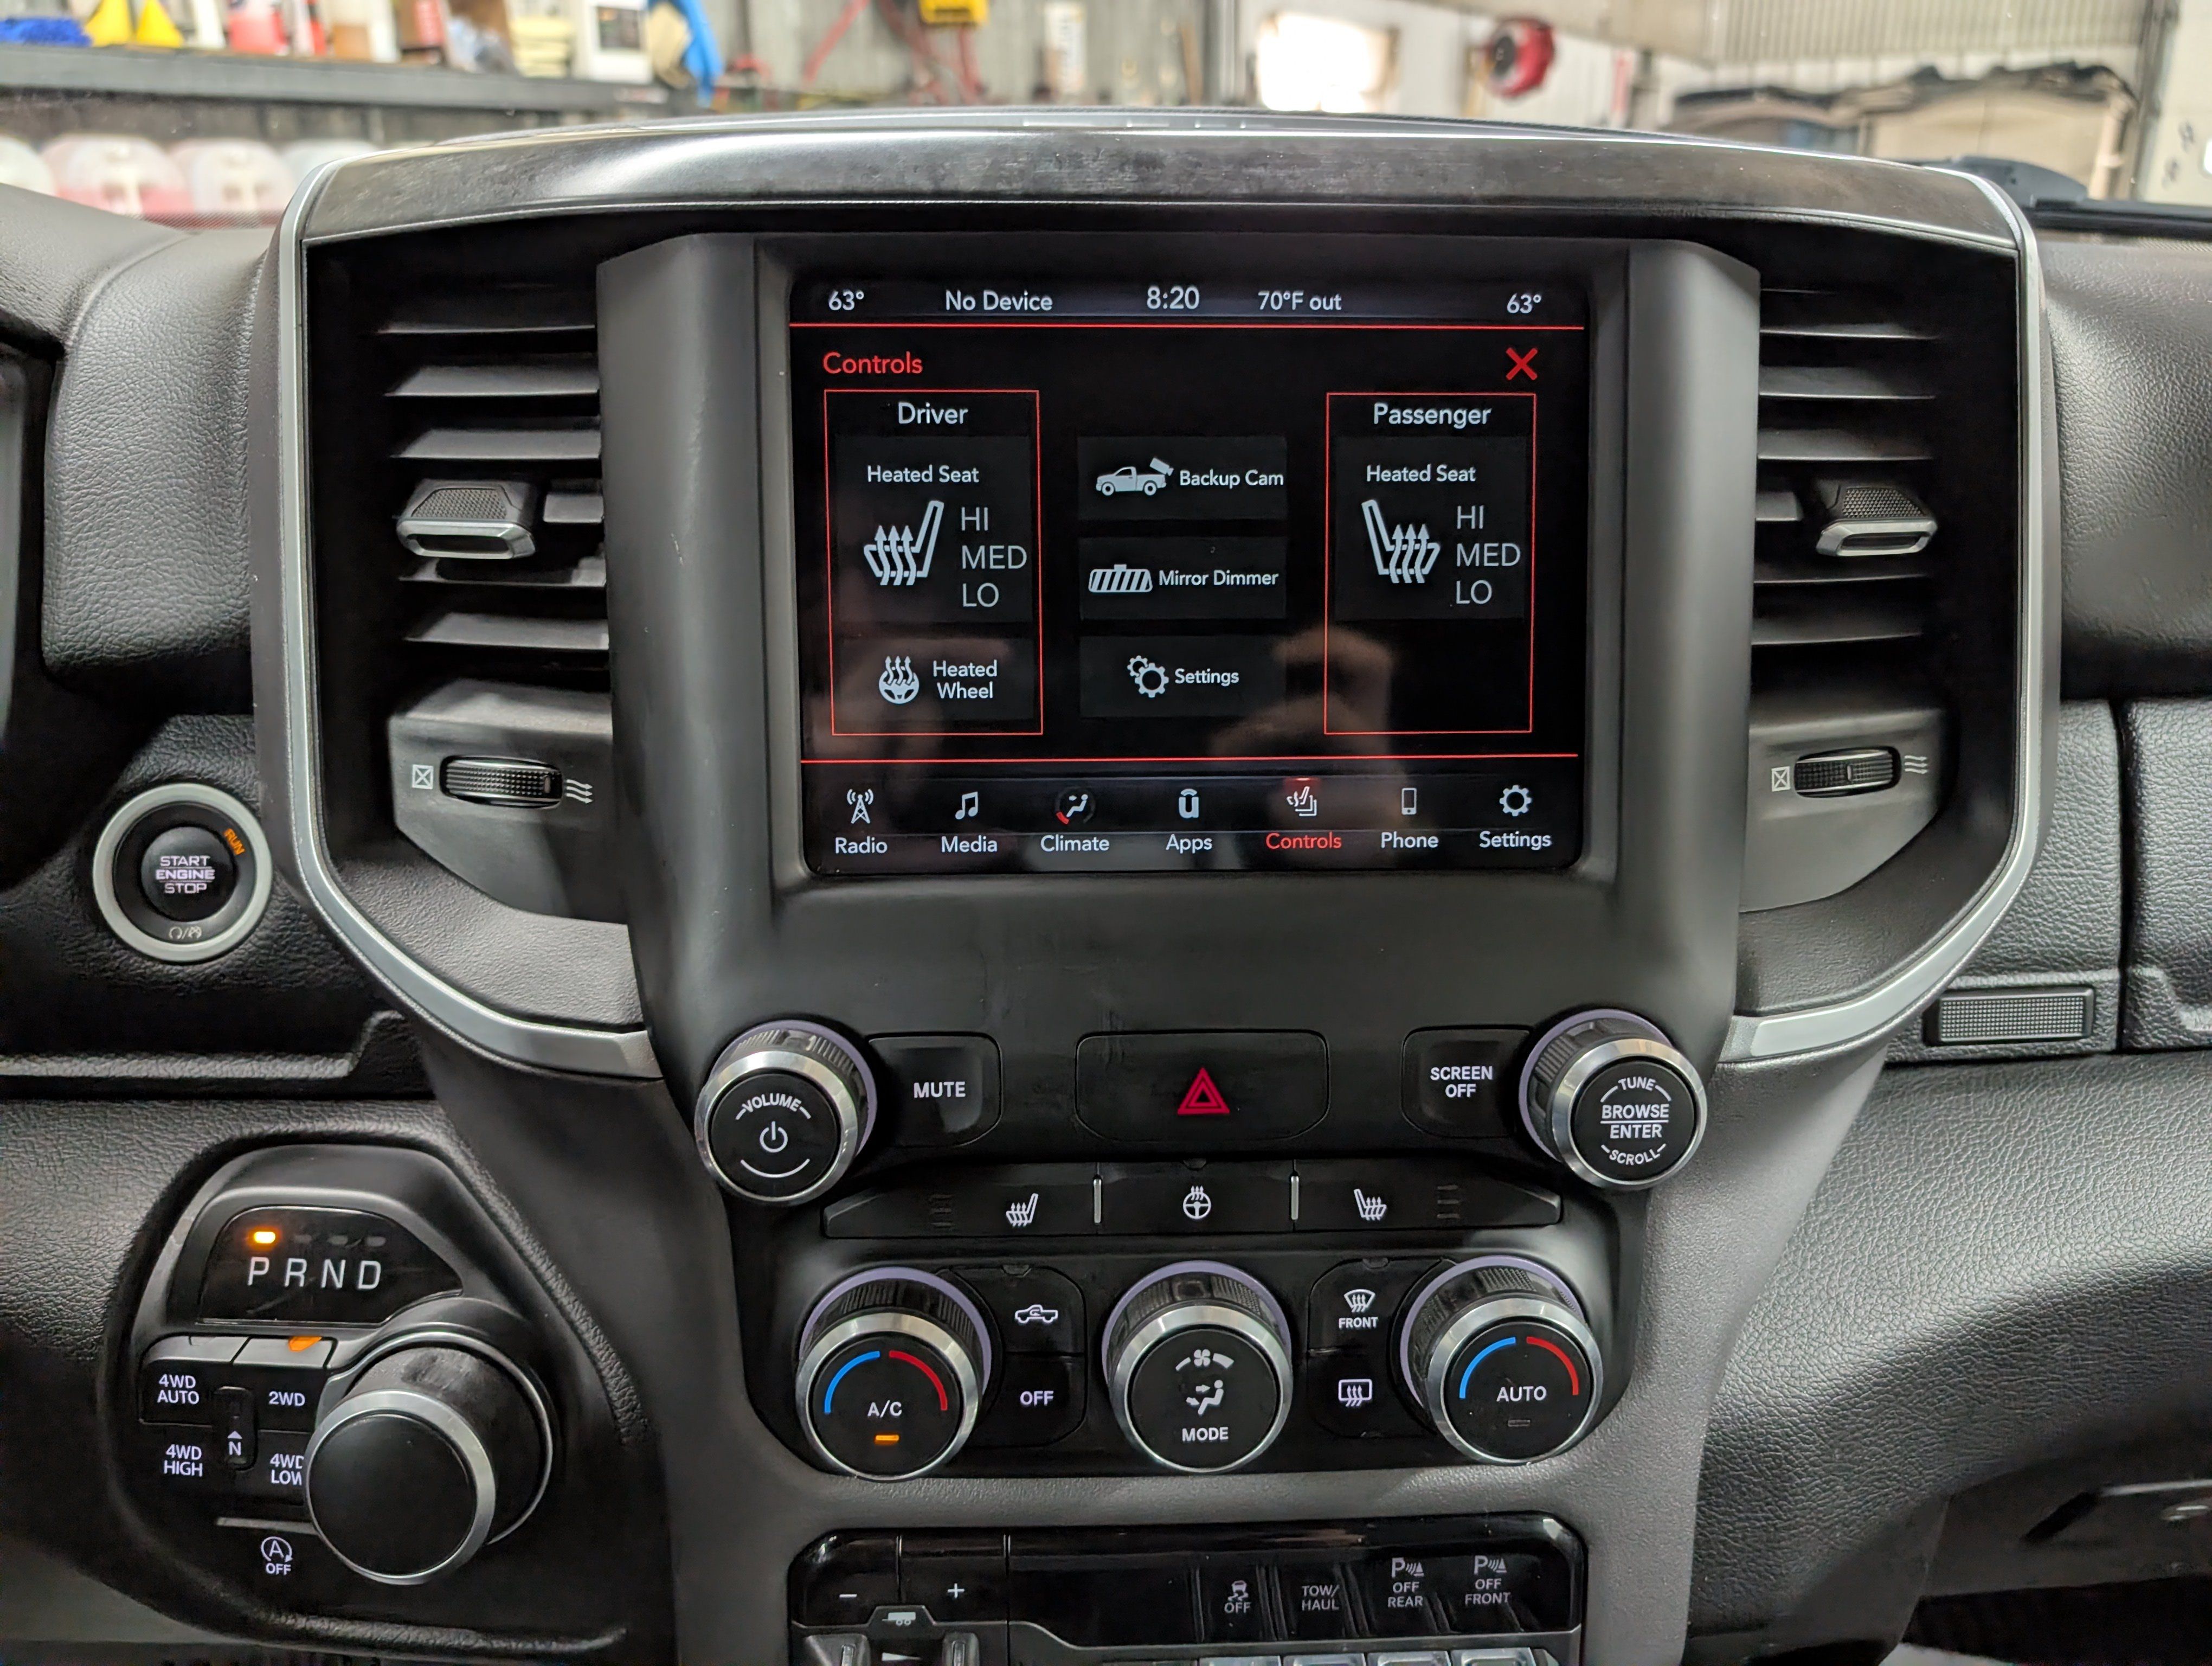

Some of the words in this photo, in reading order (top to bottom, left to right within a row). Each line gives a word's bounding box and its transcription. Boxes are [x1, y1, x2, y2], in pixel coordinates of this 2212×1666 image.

[828, 291, 865, 312] 63°
[946, 290, 976, 311] No
[983, 290, 1053, 311] Device
[1147, 286, 1200, 310] 8:20
[1258, 292, 1304, 311] 70°F
[1309, 292, 1342, 311] out
[1507, 294, 1542, 314] 63°
[822, 351, 923, 374] Controls
[898, 402, 968, 425] Driver
[1374, 403, 1491, 429] Passenger
[867, 465, 933, 483] Heated
[939, 466, 980, 483] Seat
[1180, 469, 1240, 489] Backup
[1245, 469, 1284, 486] Cam
[1367, 464, 1431, 482] Heated
[1436, 464, 1476, 482] Seat
[961, 507, 988, 531] HI
[1456, 505, 1484, 529] HI
[962, 545, 1027, 569] MED
[1456, 543, 1521, 567] MED
[1159, 569, 1209, 586] Mirror
[1213, 569, 1279, 586] Dimmer
[962, 582, 999, 607] LO
[1456, 580, 1493, 604] LO
[933, 659, 998, 677] Heated
[1174, 668, 1239, 687] Settings
[936, 682, 994, 699] Wheel
[224, 828, 245, 855] RUN
[835, 836, 888, 854] Radio
[941, 835, 998, 853] Media
[1040, 834, 1110, 852] Climate
[1166, 834, 1213, 853] Apps
[1265, 831, 1342, 850] Controls
[1381, 832, 1439, 848] Phone
[1479, 830, 1552, 850] Settings
[160, 855, 210, 866] START
[155, 869, 215, 880] ENGINE
[164, 883, 207, 894] STOP
[1430, 1066, 1493, 1080] SCREEN
[914, 1081, 966, 1098] MUTE
[1445, 1084, 1476, 1098] OFF
[1618, 1077, 1656, 1091] TUNE
[742, 1093, 802, 1113] VOLUME
[1602, 1104, 1669, 1119] BROWSE
[1610, 1124, 1662, 1139] ENTER
[1609, 1149, 1660, 1165] SCROLL
[248, 1257, 269, 1286] P
[284, 1258, 307, 1287] R
[320, 1259, 346, 1288] N
[357, 1260, 381, 1289] D
[1339, 1317, 1378, 1329] FRONT
[158, 1374, 196, 1389] 4WD
[157, 1389, 200, 1405] AUTO
[268, 1391, 305, 1406] 2WD
[1020, 1391, 1054, 1406] OFF
[1496, 1386, 1547, 1402] AUTO
[867, 1400, 902, 1417] A/C
[1182, 1427, 1229, 1442] MODE
[166, 1444, 202, 1460] 4WD
[228, 1441, 241, 1456] N
[163, 1460, 203, 1477] HIGH
[266, 1562, 291, 1575] OFF
[1391, 1558, 1405, 1578] P
[1474, 1555, 1488, 1575] P
[1302, 1585, 1340, 1597] TOW/
[1392, 1582, 1419, 1593] OFF
[1475, 1578, 1502, 1590] OFF
[1302, 1599, 1339, 1611] HAUL
[1387, 1595, 1423, 1607] REAR
[1465, 1592, 1511, 1605] FRONT
[1224, 1602, 1251, 1613] OFF
